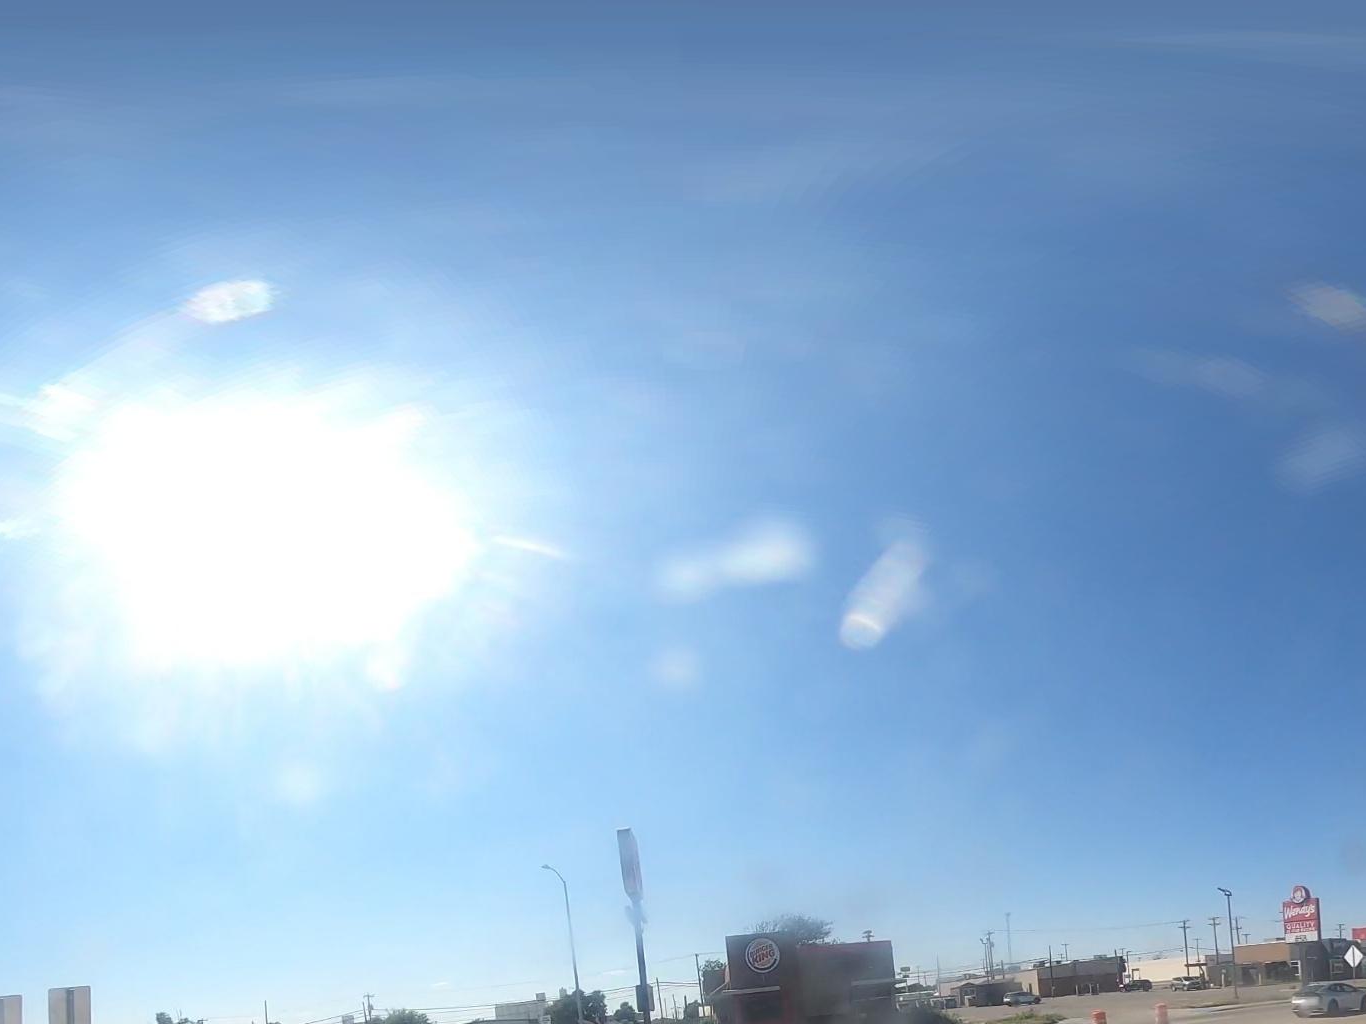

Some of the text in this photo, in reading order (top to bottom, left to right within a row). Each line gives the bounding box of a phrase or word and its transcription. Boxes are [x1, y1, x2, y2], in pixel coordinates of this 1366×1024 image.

[1284, 904, 1316, 920] Wendy's
[1286, 921, 1315, 930] QUALITY
[751, 949, 775, 964] KING
